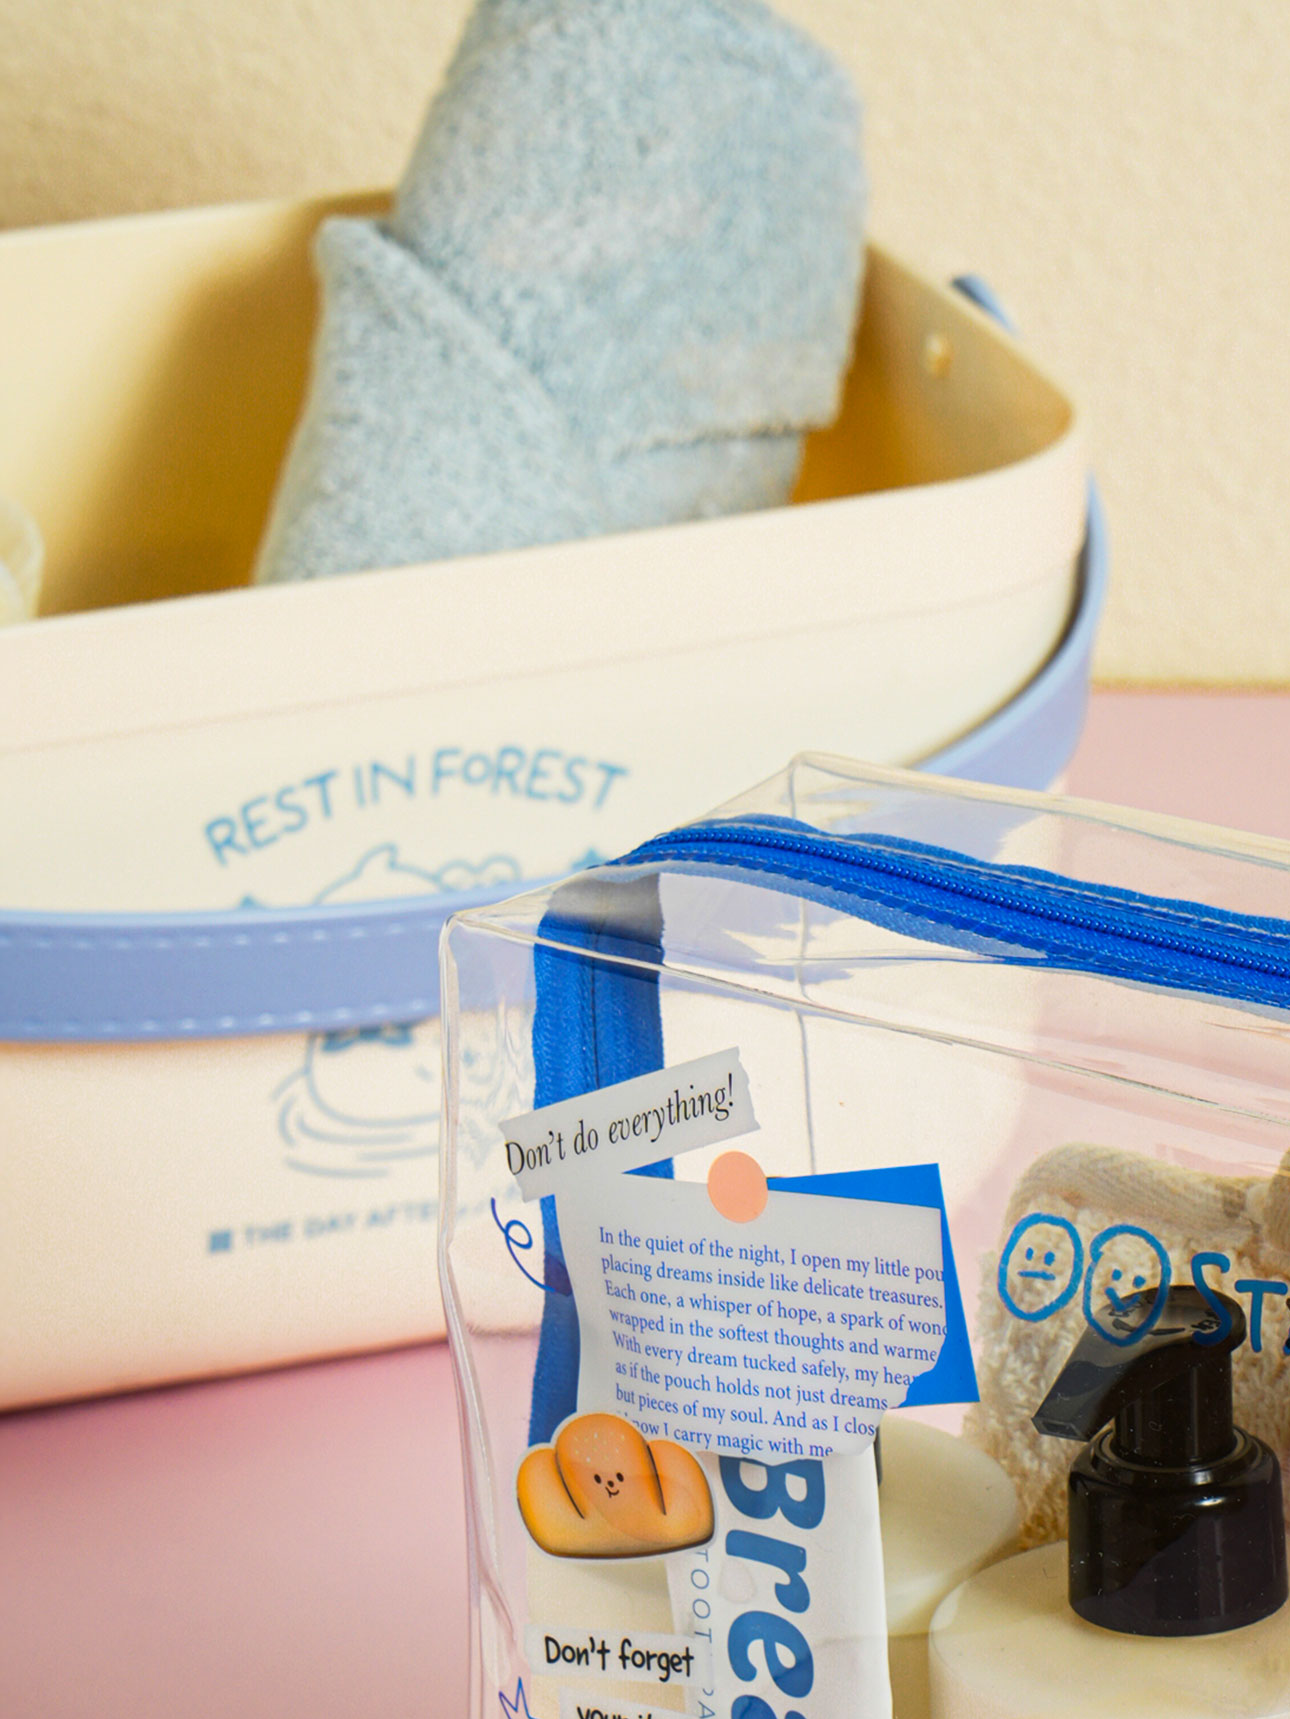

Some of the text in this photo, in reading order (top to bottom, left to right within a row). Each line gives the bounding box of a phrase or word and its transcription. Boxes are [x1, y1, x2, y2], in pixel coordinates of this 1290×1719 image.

[204, 768, 338, 867] REST
[353, 754, 416, 808] IN
[573, 1119, 599, 1156] do
[608, 1072, 735, 1144] everything!
[365, 1200, 440, 1229] AFTE
[599, 1227, 614, 1244] In
[618, 1229, 641, 1248] the
[645, 1236, 684, 1255] quiet
[689, 1238, 706, 1255] of
[709, 1240, 733, 1258] the
[739, 1244, 785, 1267] night,
[790, 1248, 797, 1265] I
[801, 1254, 841, 1272] open
[846, 1258, 870, 1278] my
[874, 1257, 910, 1278] little
[601, 1254, 943, 1309] placing dreams inside like delicate treasures.
[605, 1279, 636, 1301] Each
[640, 1290, 671, 1308] one,
[676, 1295, 684, 1308] a
[689, 1293, 752, 1318] whisper
[757, 1301, 774, 1318] of
[777, 1300, 822, 1325] hope,
[827, 1311, 835, 1324] a
[840, 1311, 884, 1331] spark
[888, 1313, 905, 1331] of
[609, 1309, 937, 1362] wrapped in the softest thoughts and warme
[612, 1331, 641, 1354] With
[644, 1344, 683, 1366] every
[687, 1346, 737, 1367] dream
[743, 1353, 797, 1373] tucked
[801, 1360, 850, 1383] safely,
[855, 1368, 878, 1387] my
[615, 1361, 888, 1410] as if the pouch holds not just dreams
[616, 1383, 635, 1404] but
[639, 1393, 678, 1414] pieces
[683, 1400, 699, 1417] of
[702, 1406, 725, 1424] my
[730, 1407, 768, 1425] soul.
[773, 1410, 807, 1428] And
[812, 1418, 828, 1430] as
[833, 1415, 839, 1432] I
[663, 1422, 668, 1436] I
[673, 1428, 713, 1449] carry
[717, 1434, 764, 1455] magic
[768, 1437, 803, 1455] with
[809, 1444, 833, 1457] me
[544, 1636, 695, 1682] Don't forget
